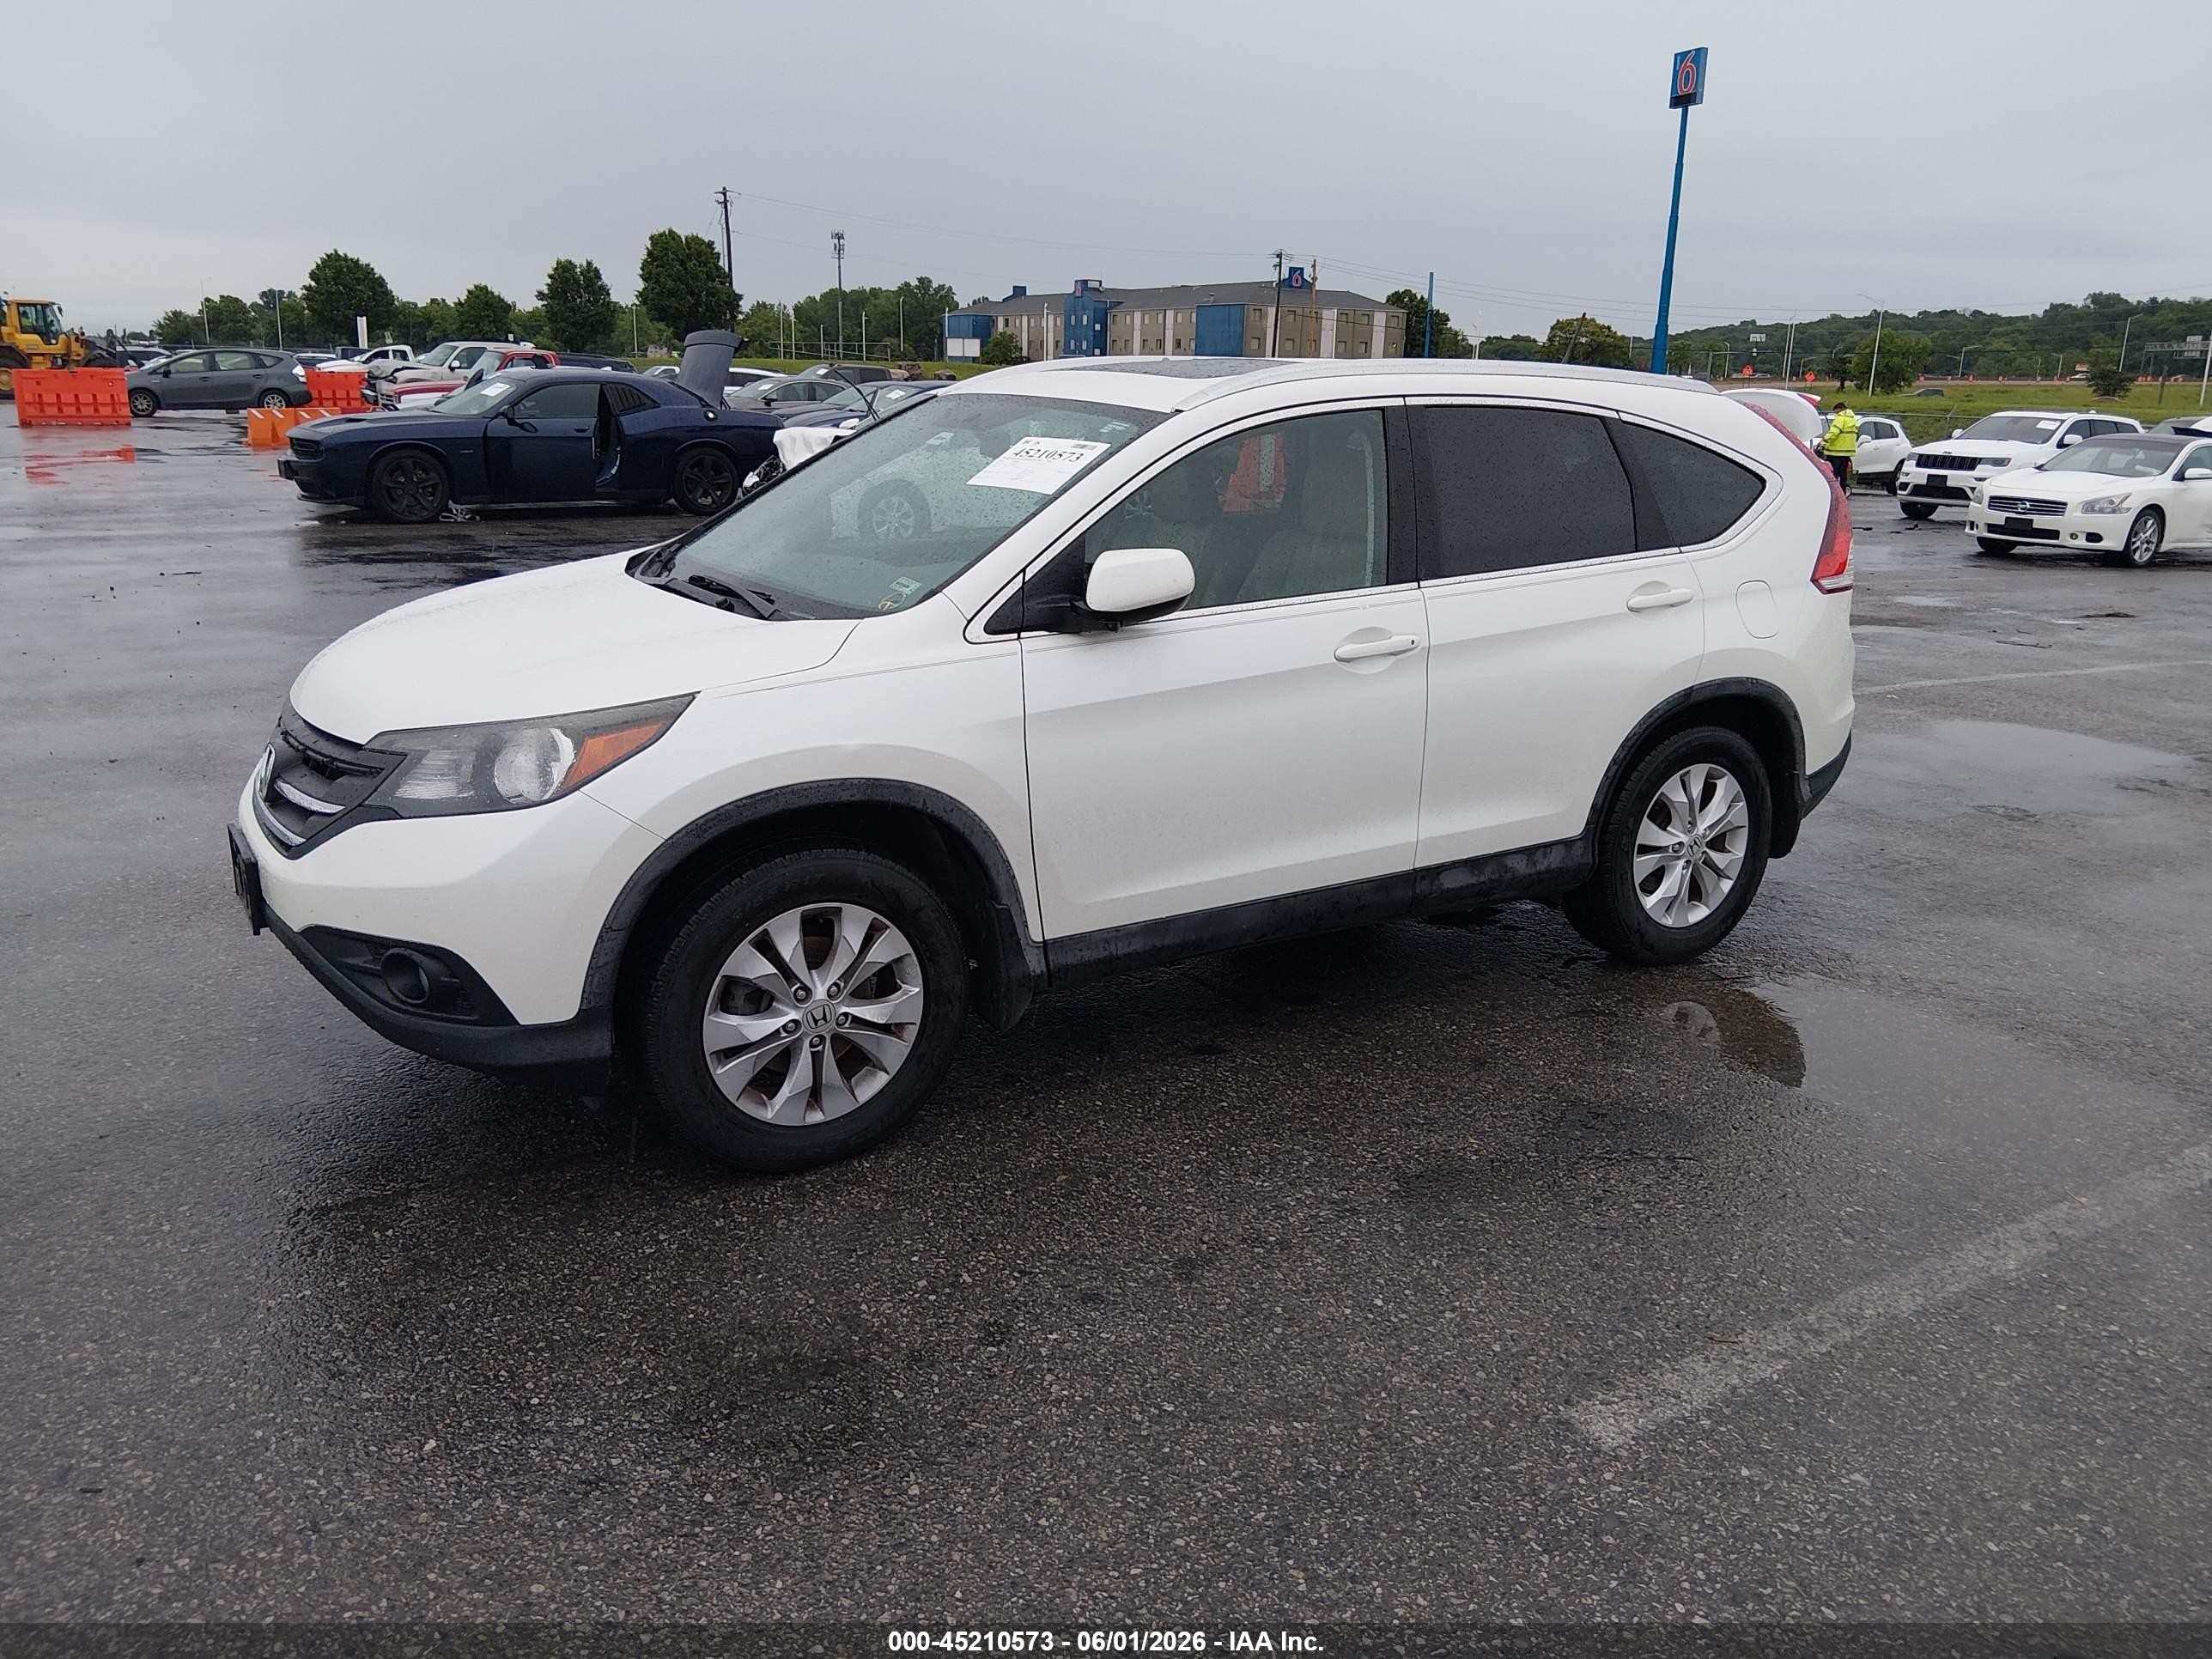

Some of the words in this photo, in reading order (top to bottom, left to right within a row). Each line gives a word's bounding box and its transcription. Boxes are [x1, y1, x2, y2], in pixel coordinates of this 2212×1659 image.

[1677, 50, 1697, 95] 6
[1291, 270, 1303, 288] 6
[1013, 447, 1085, 462] 45210573
